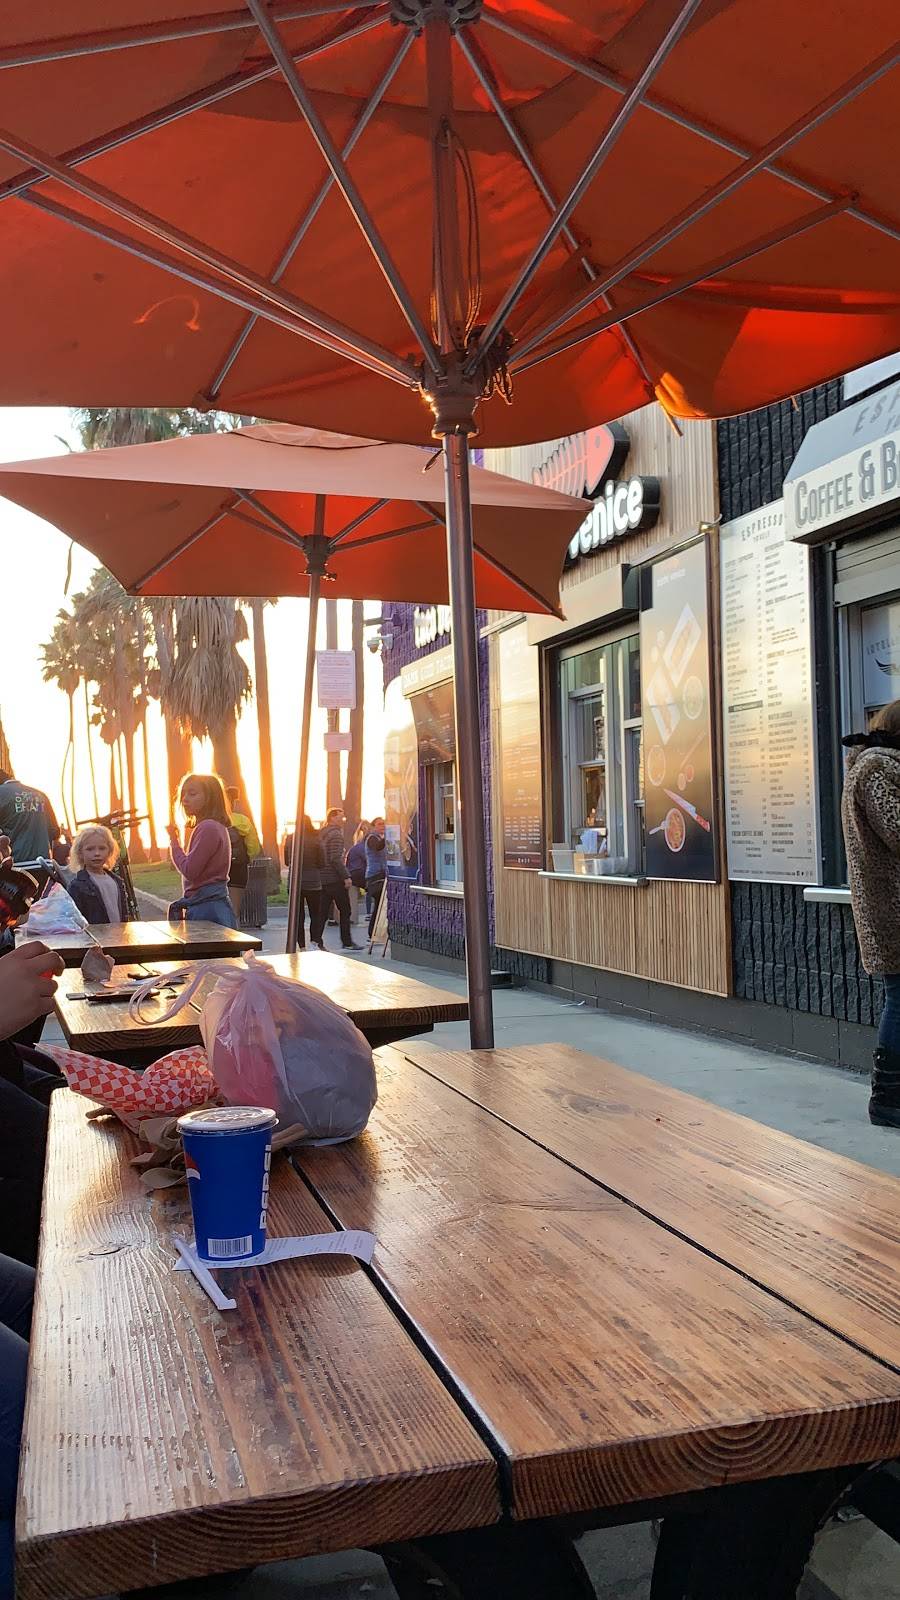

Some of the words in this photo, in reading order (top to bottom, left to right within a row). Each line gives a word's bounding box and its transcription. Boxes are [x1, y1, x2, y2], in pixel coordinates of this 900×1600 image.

[794, 472, 854, 528] COFFEE
[858, 449, 875, 503] &
[741, 513, 783, 541] ESPRESSO
